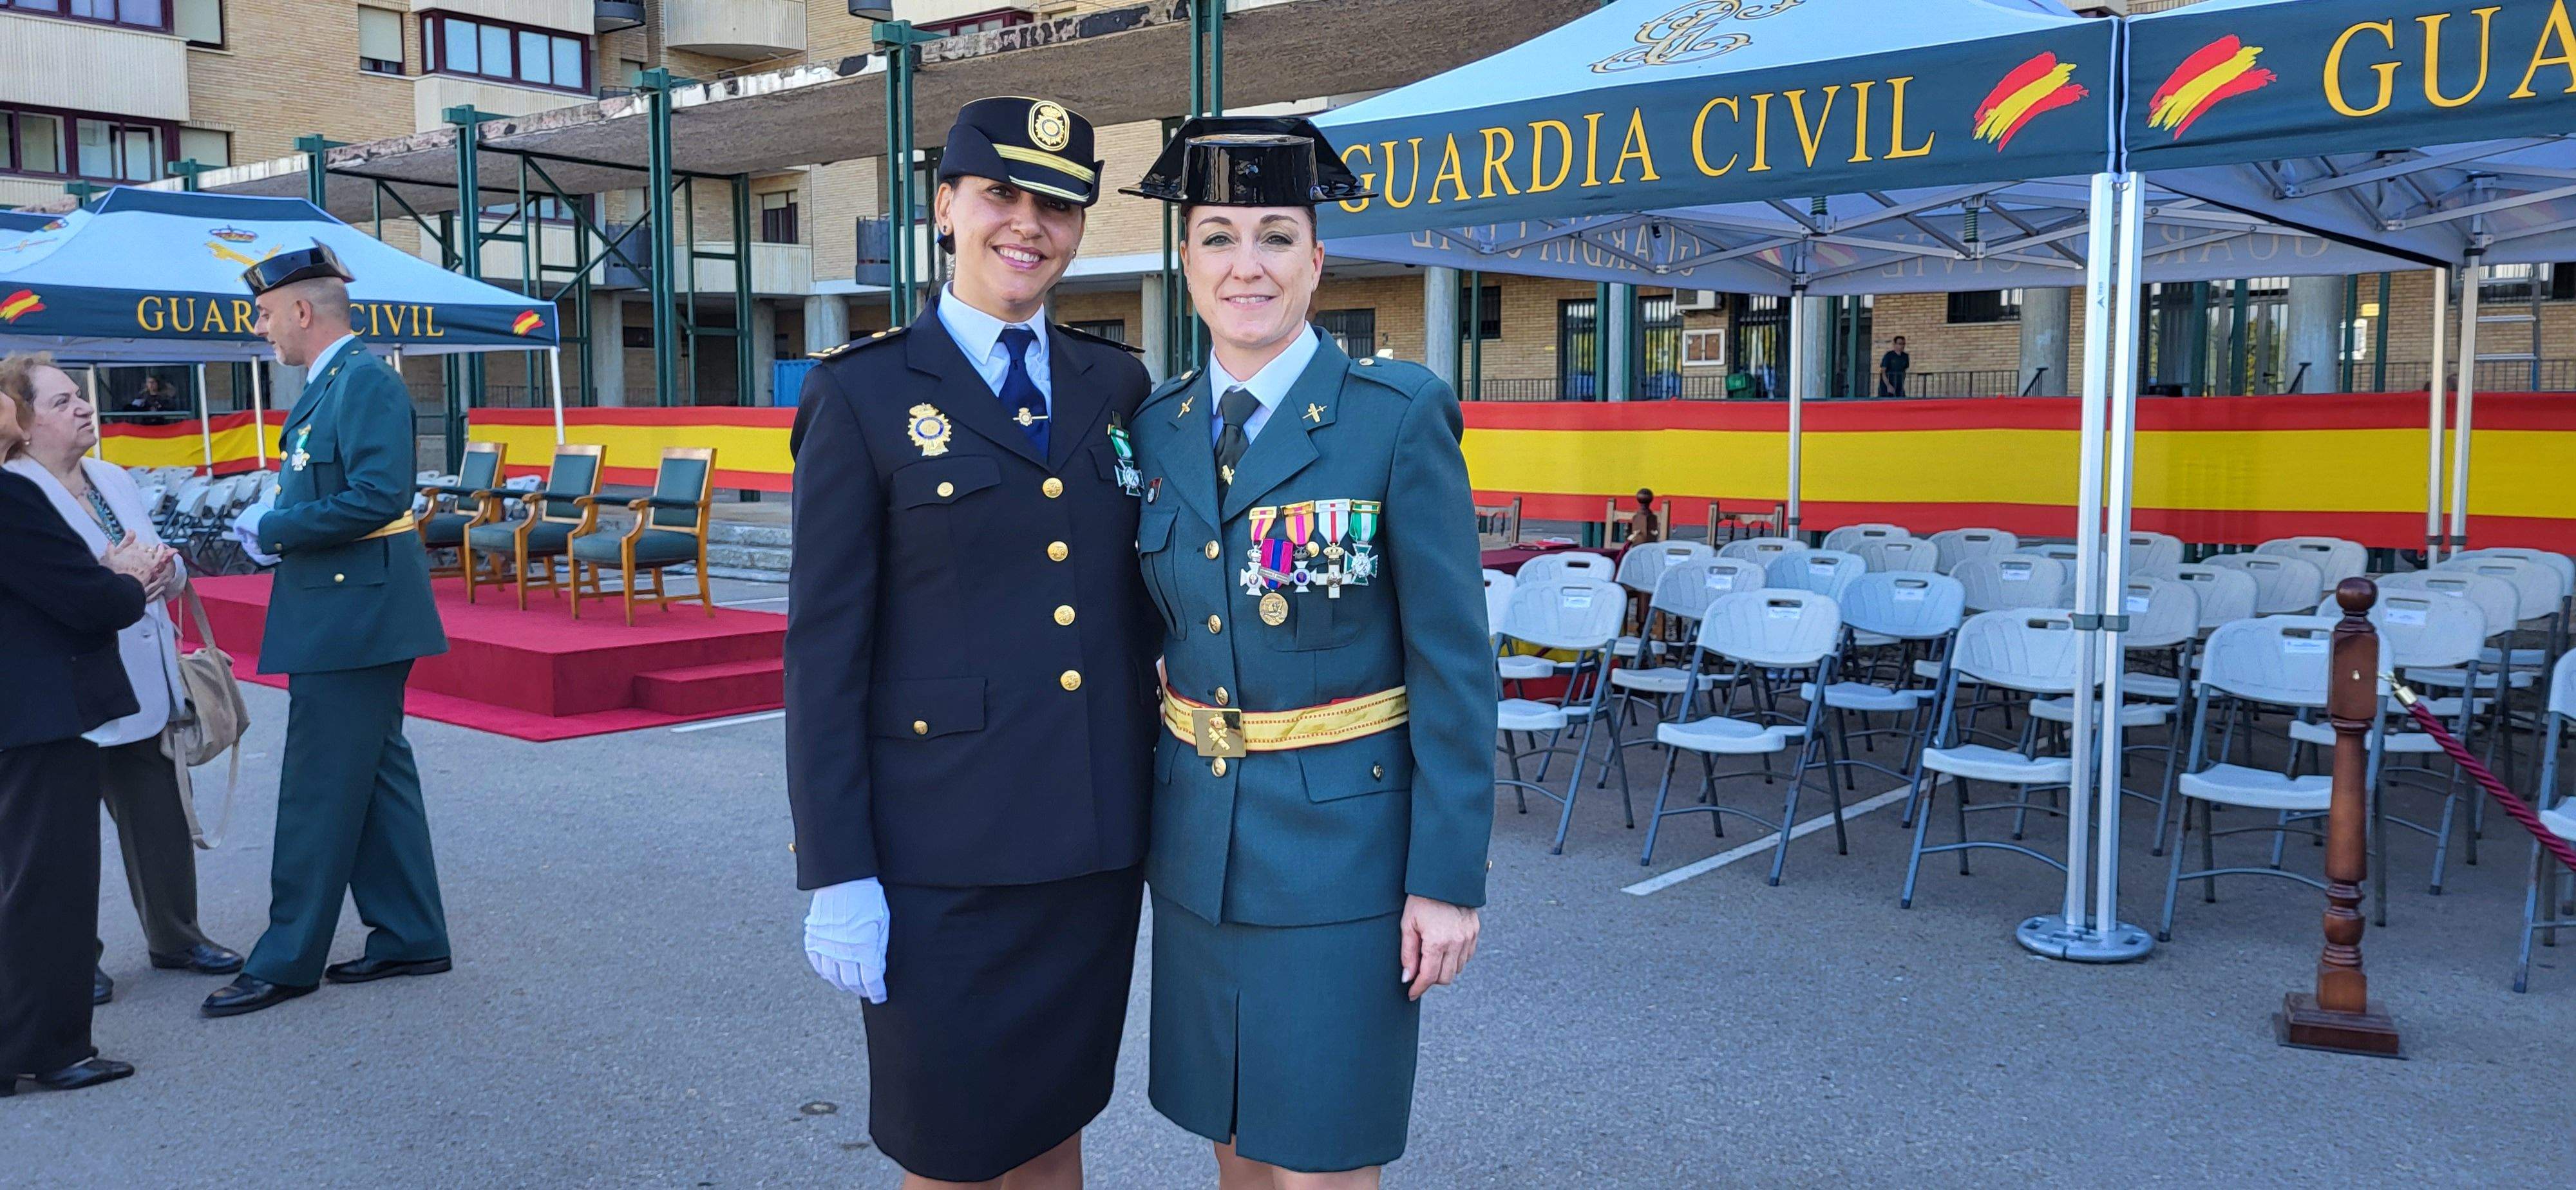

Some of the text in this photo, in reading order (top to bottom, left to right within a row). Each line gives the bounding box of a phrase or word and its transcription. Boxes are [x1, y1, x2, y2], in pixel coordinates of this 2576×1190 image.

[1338, 75, 1935, 213] GUARDIA CIVIL
[137, 296, 258, 334] GUAR
